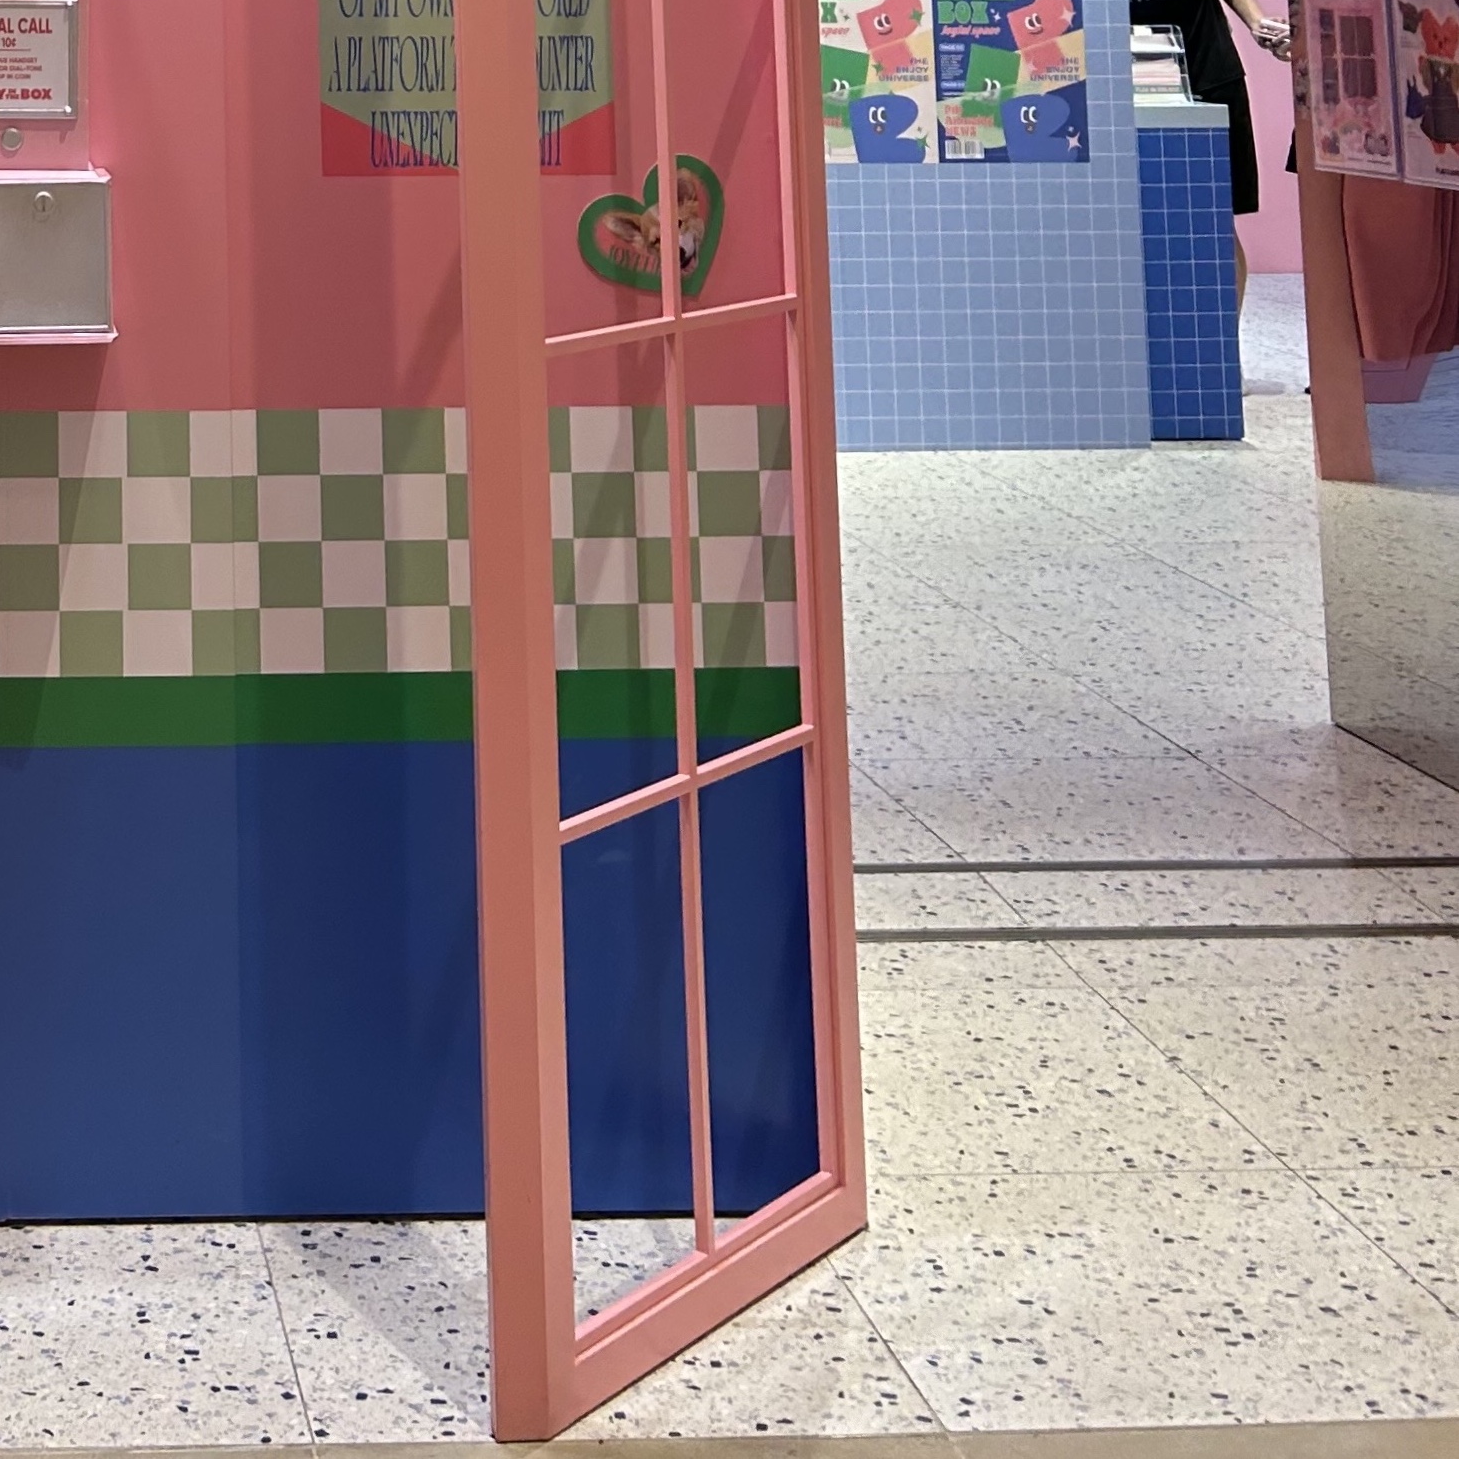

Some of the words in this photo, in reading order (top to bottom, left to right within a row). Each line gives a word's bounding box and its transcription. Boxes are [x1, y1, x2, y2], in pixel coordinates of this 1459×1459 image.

[937, 1, 989, 24] BOX
[17, 17, 53, 34] CALL
[327, 35, 342, 93] A
[345, 35, 448, 93] PLATFORM
[895, 66, 930, 74] ENJOY
[1046, 66, 1080, 74] ENJOY
[878, 74, 930, 82] UNIVERSE
[1030, 74, 1080, 82] UNIVERSE
[21, 88, 53, 100] BOX
